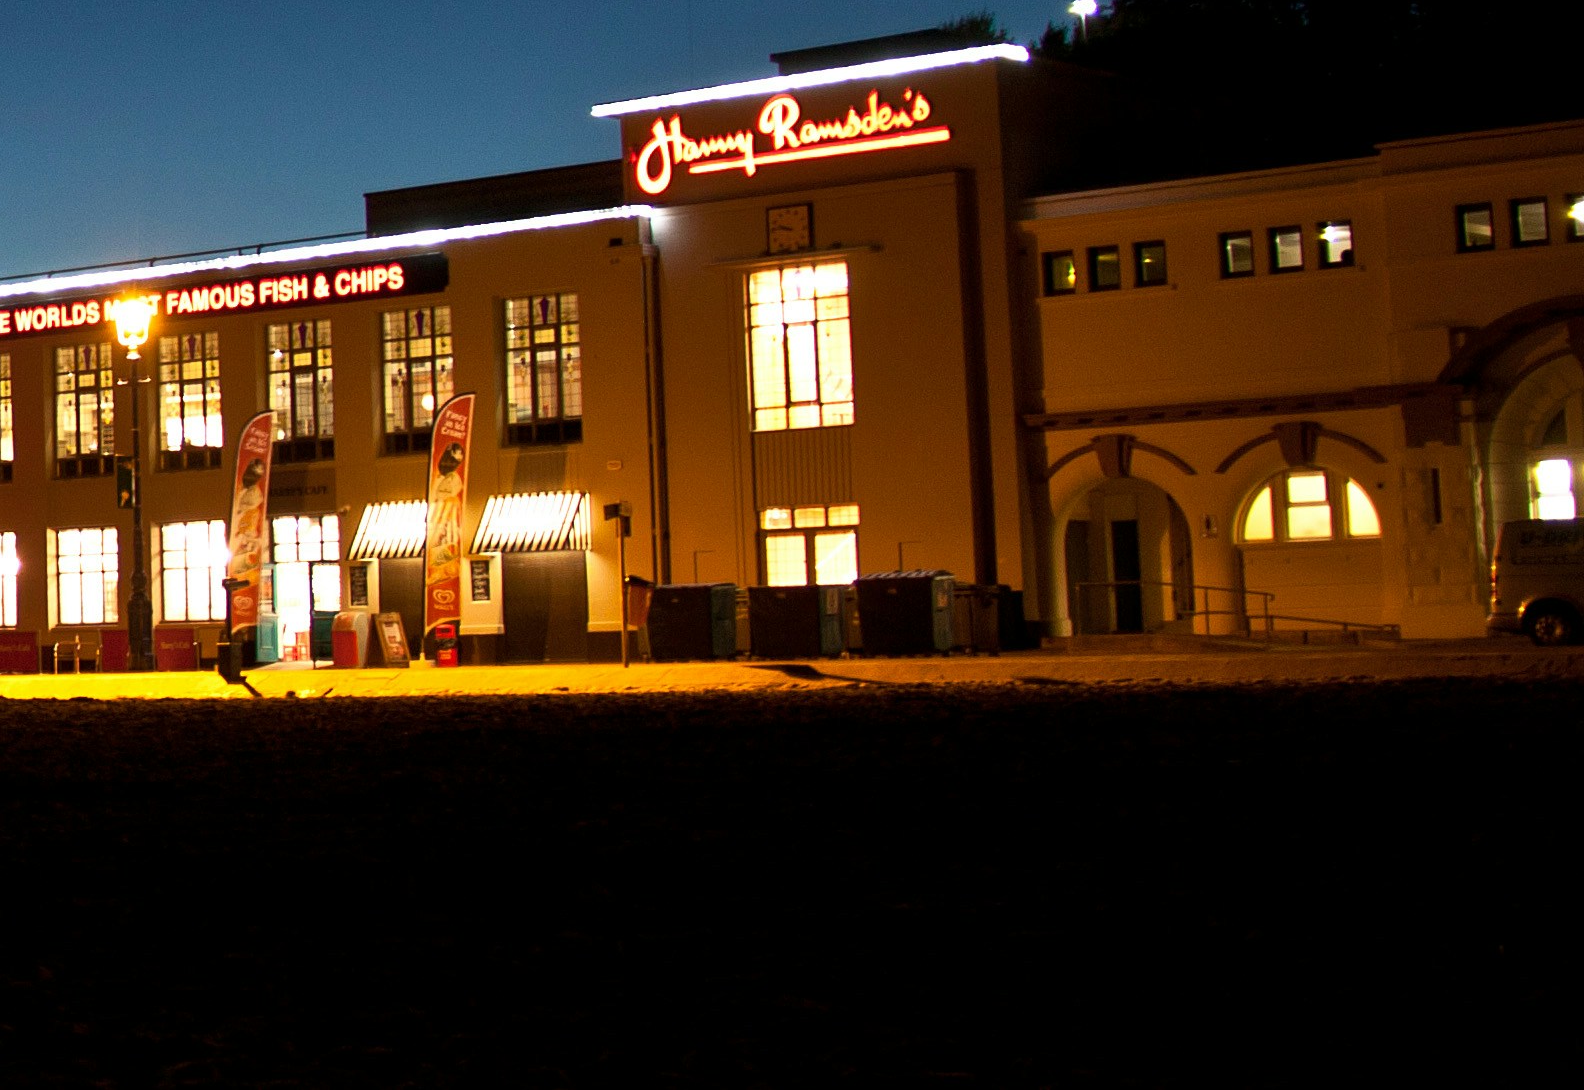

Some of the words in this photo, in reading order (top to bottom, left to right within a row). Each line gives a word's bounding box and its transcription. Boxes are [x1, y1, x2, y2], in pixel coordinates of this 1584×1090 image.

[636, 113, 756, 194] Harry
[758, 87, 931, 150] Ramsden's
[14, 299, 101, 332] WORLDS
[103, 291, 162, 322] MT
[166, 280, 256, 315] FAMOUS
[259, 274, 309, 305] FISH
[313, 270, 330, 299] &
[334, 262, 405, 296] CHIPS
